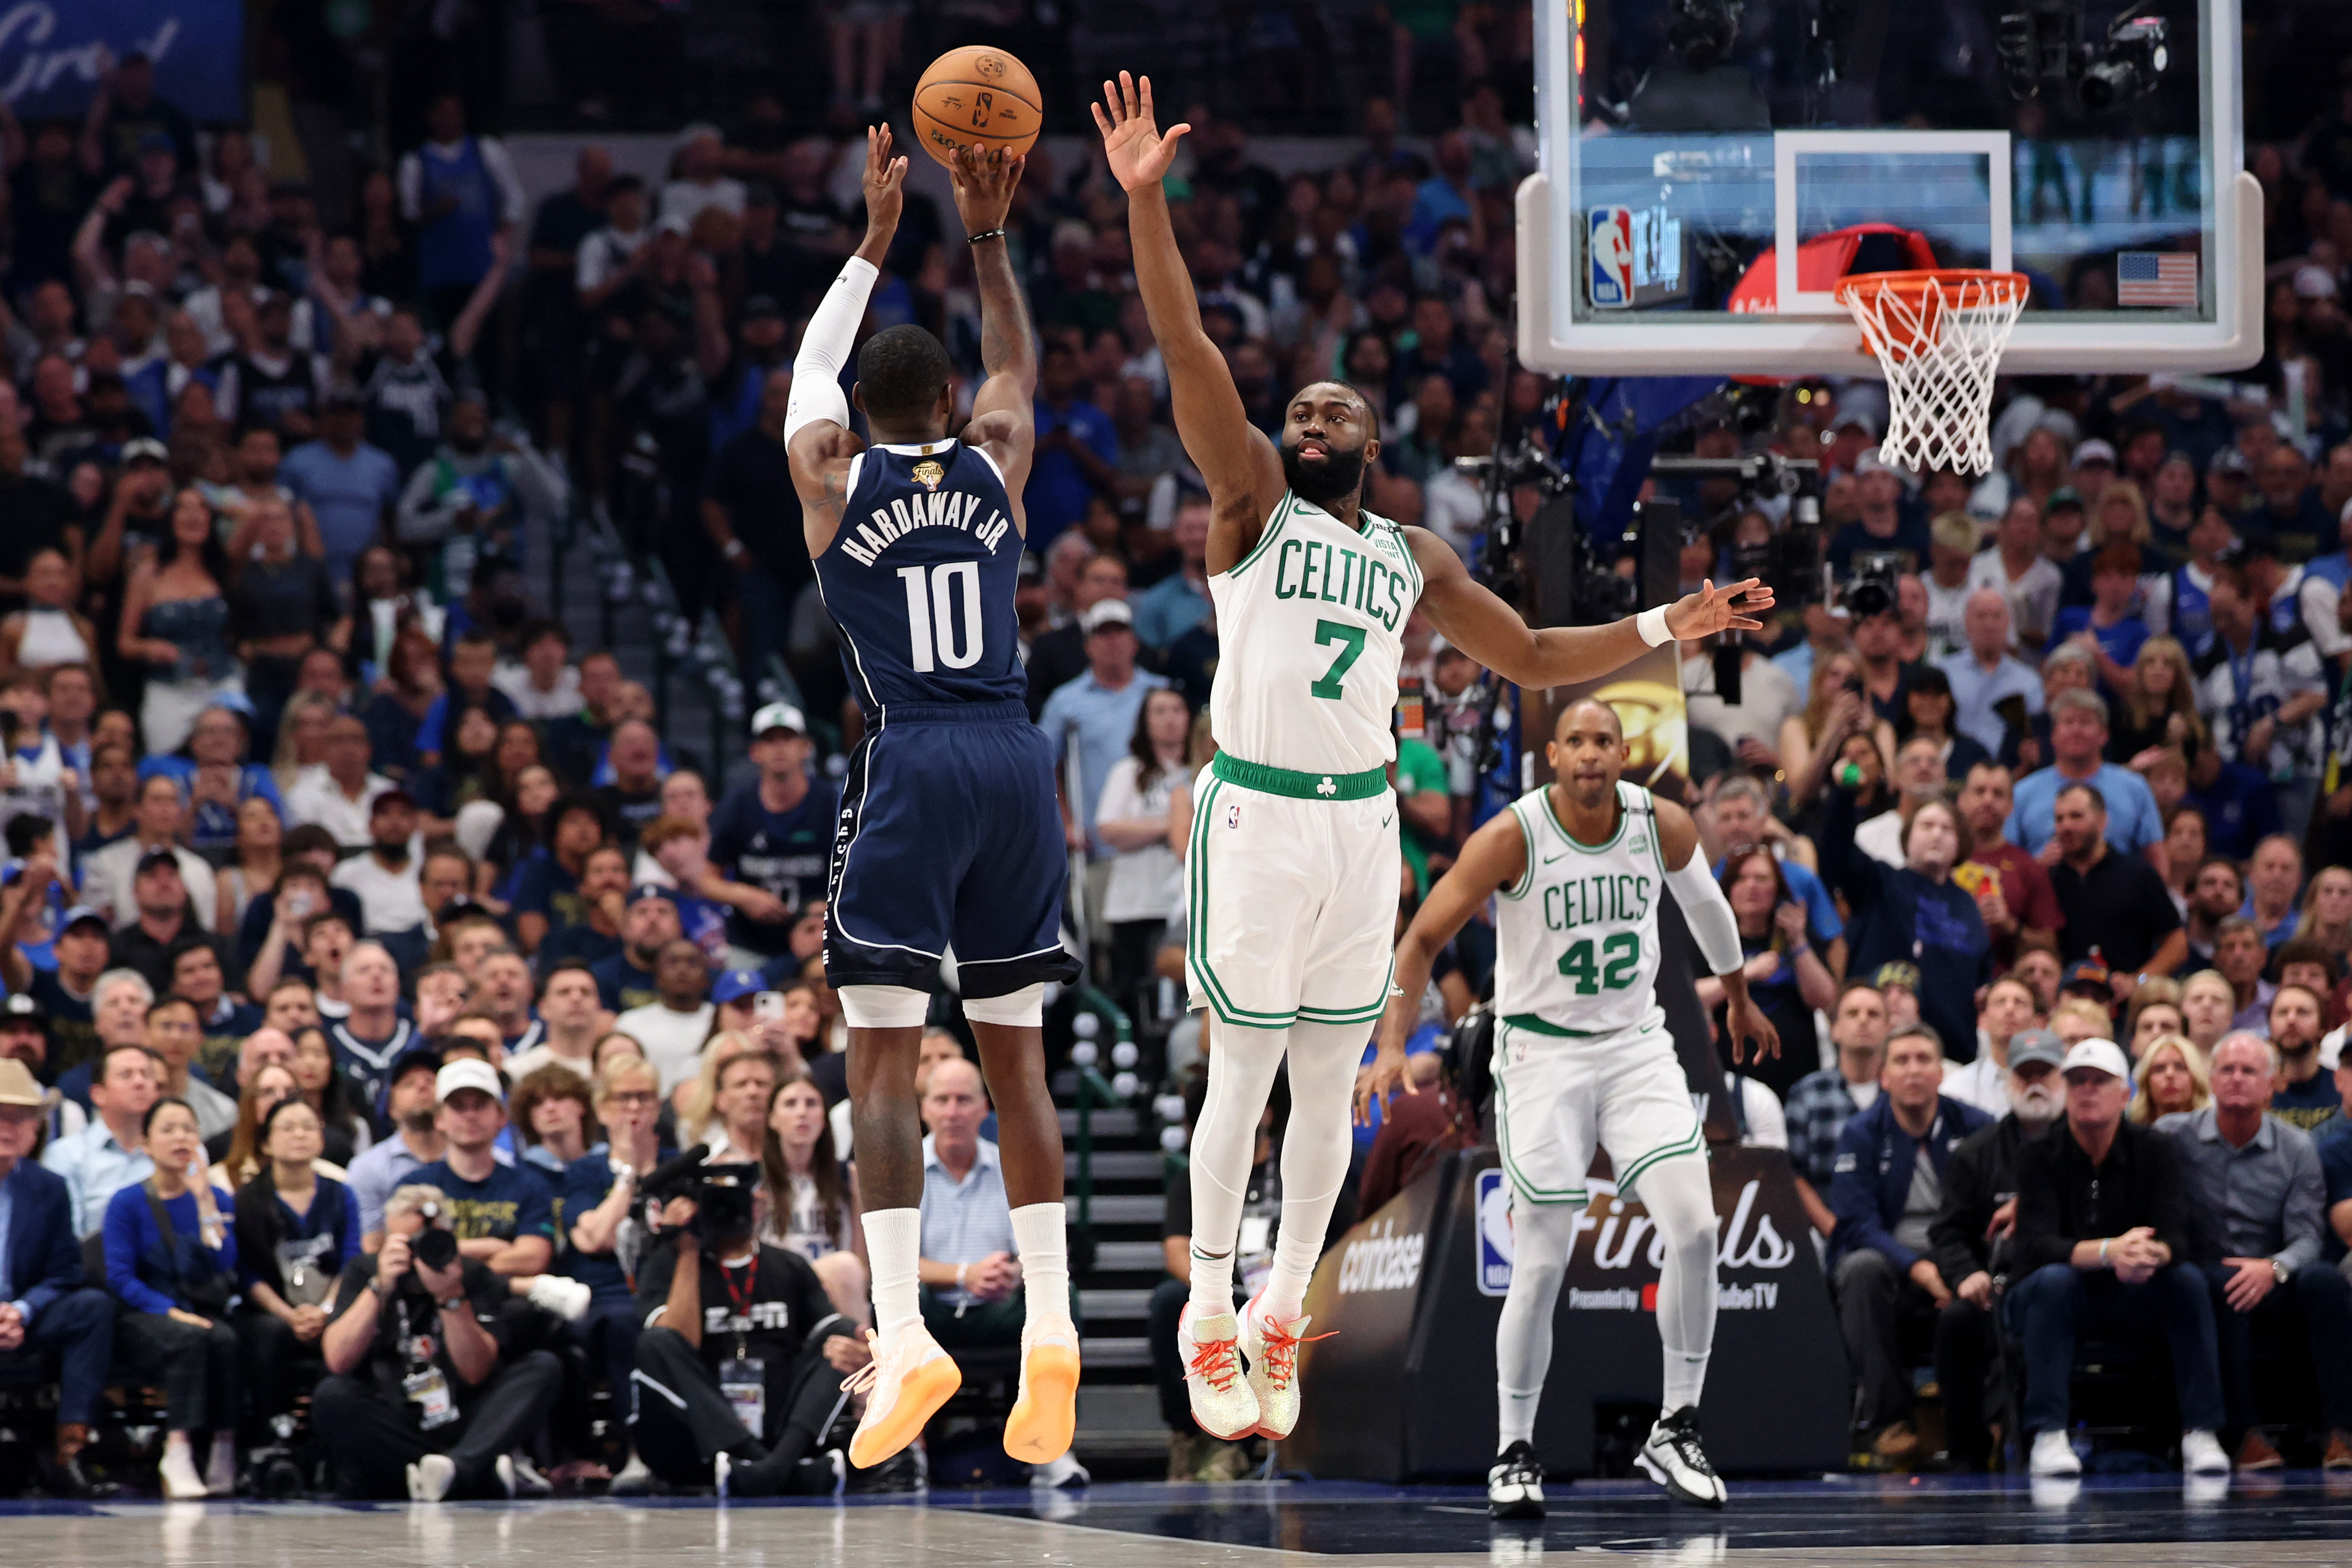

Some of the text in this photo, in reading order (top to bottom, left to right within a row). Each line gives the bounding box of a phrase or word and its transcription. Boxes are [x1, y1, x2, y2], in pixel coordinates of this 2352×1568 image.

[912, 461, 943, 481] Finals
[841, 491, 1009, 567] HARDAWAY JR.
[1373, 538, 1398, 552] VISTA
[896, 561, 983, 673] 10
[1275, 539, 1406, 632] CELTICS
[1311, 619, 1368, 700] 7
[1545, 875, 1650, 931] CELTICS
[1557, 932, 1640, 995] 42
[1338, 1217, 1424, 1295] coinbase
